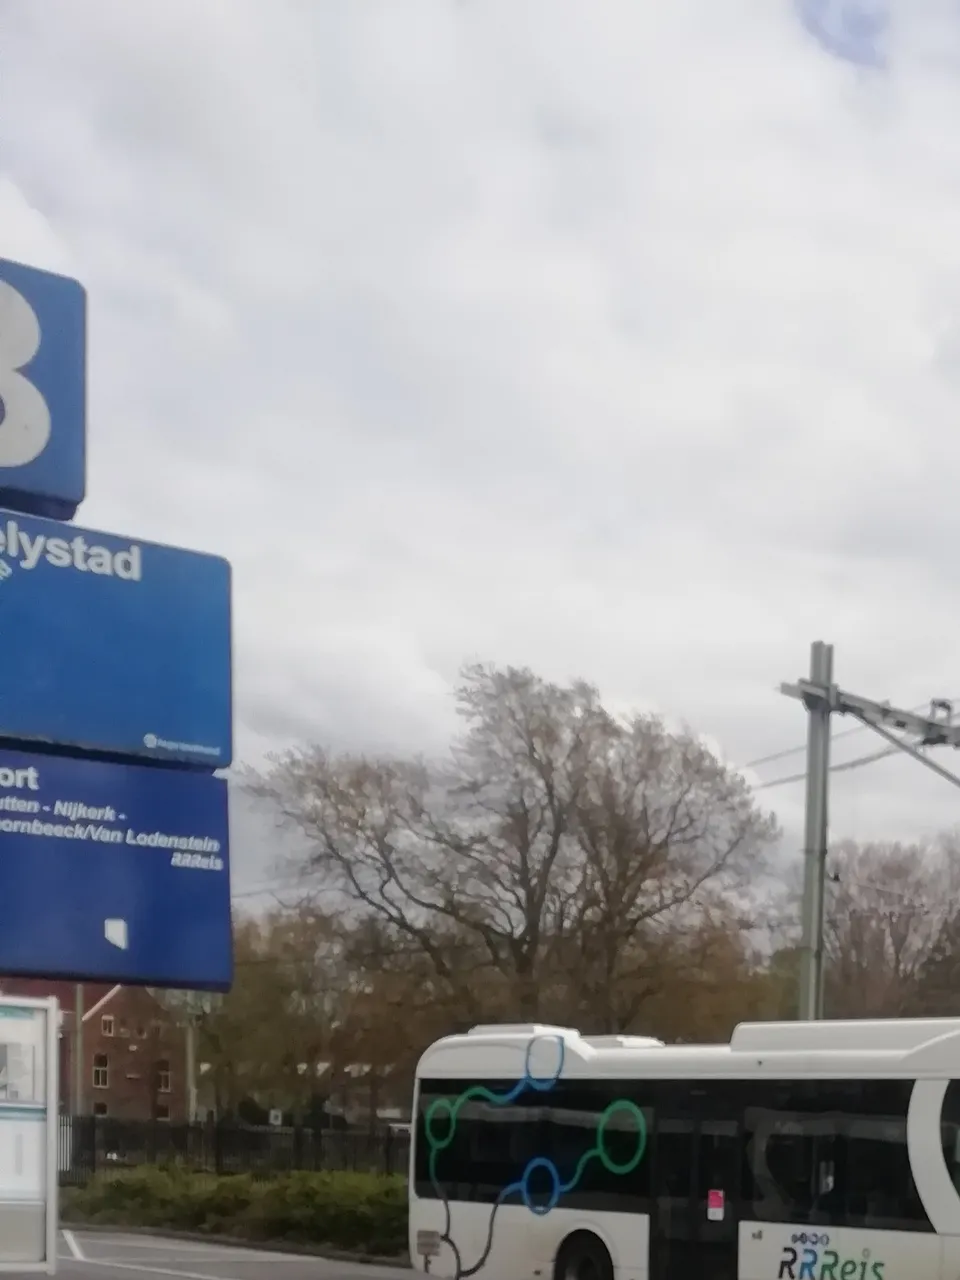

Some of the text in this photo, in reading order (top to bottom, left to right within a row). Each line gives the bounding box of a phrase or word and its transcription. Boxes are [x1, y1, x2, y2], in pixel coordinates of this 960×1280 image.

[0, 520, 141, 582] lystad
[54, 799, 116, 822] Nijkerk
[126, 828, 220, 852] Lodenstein
